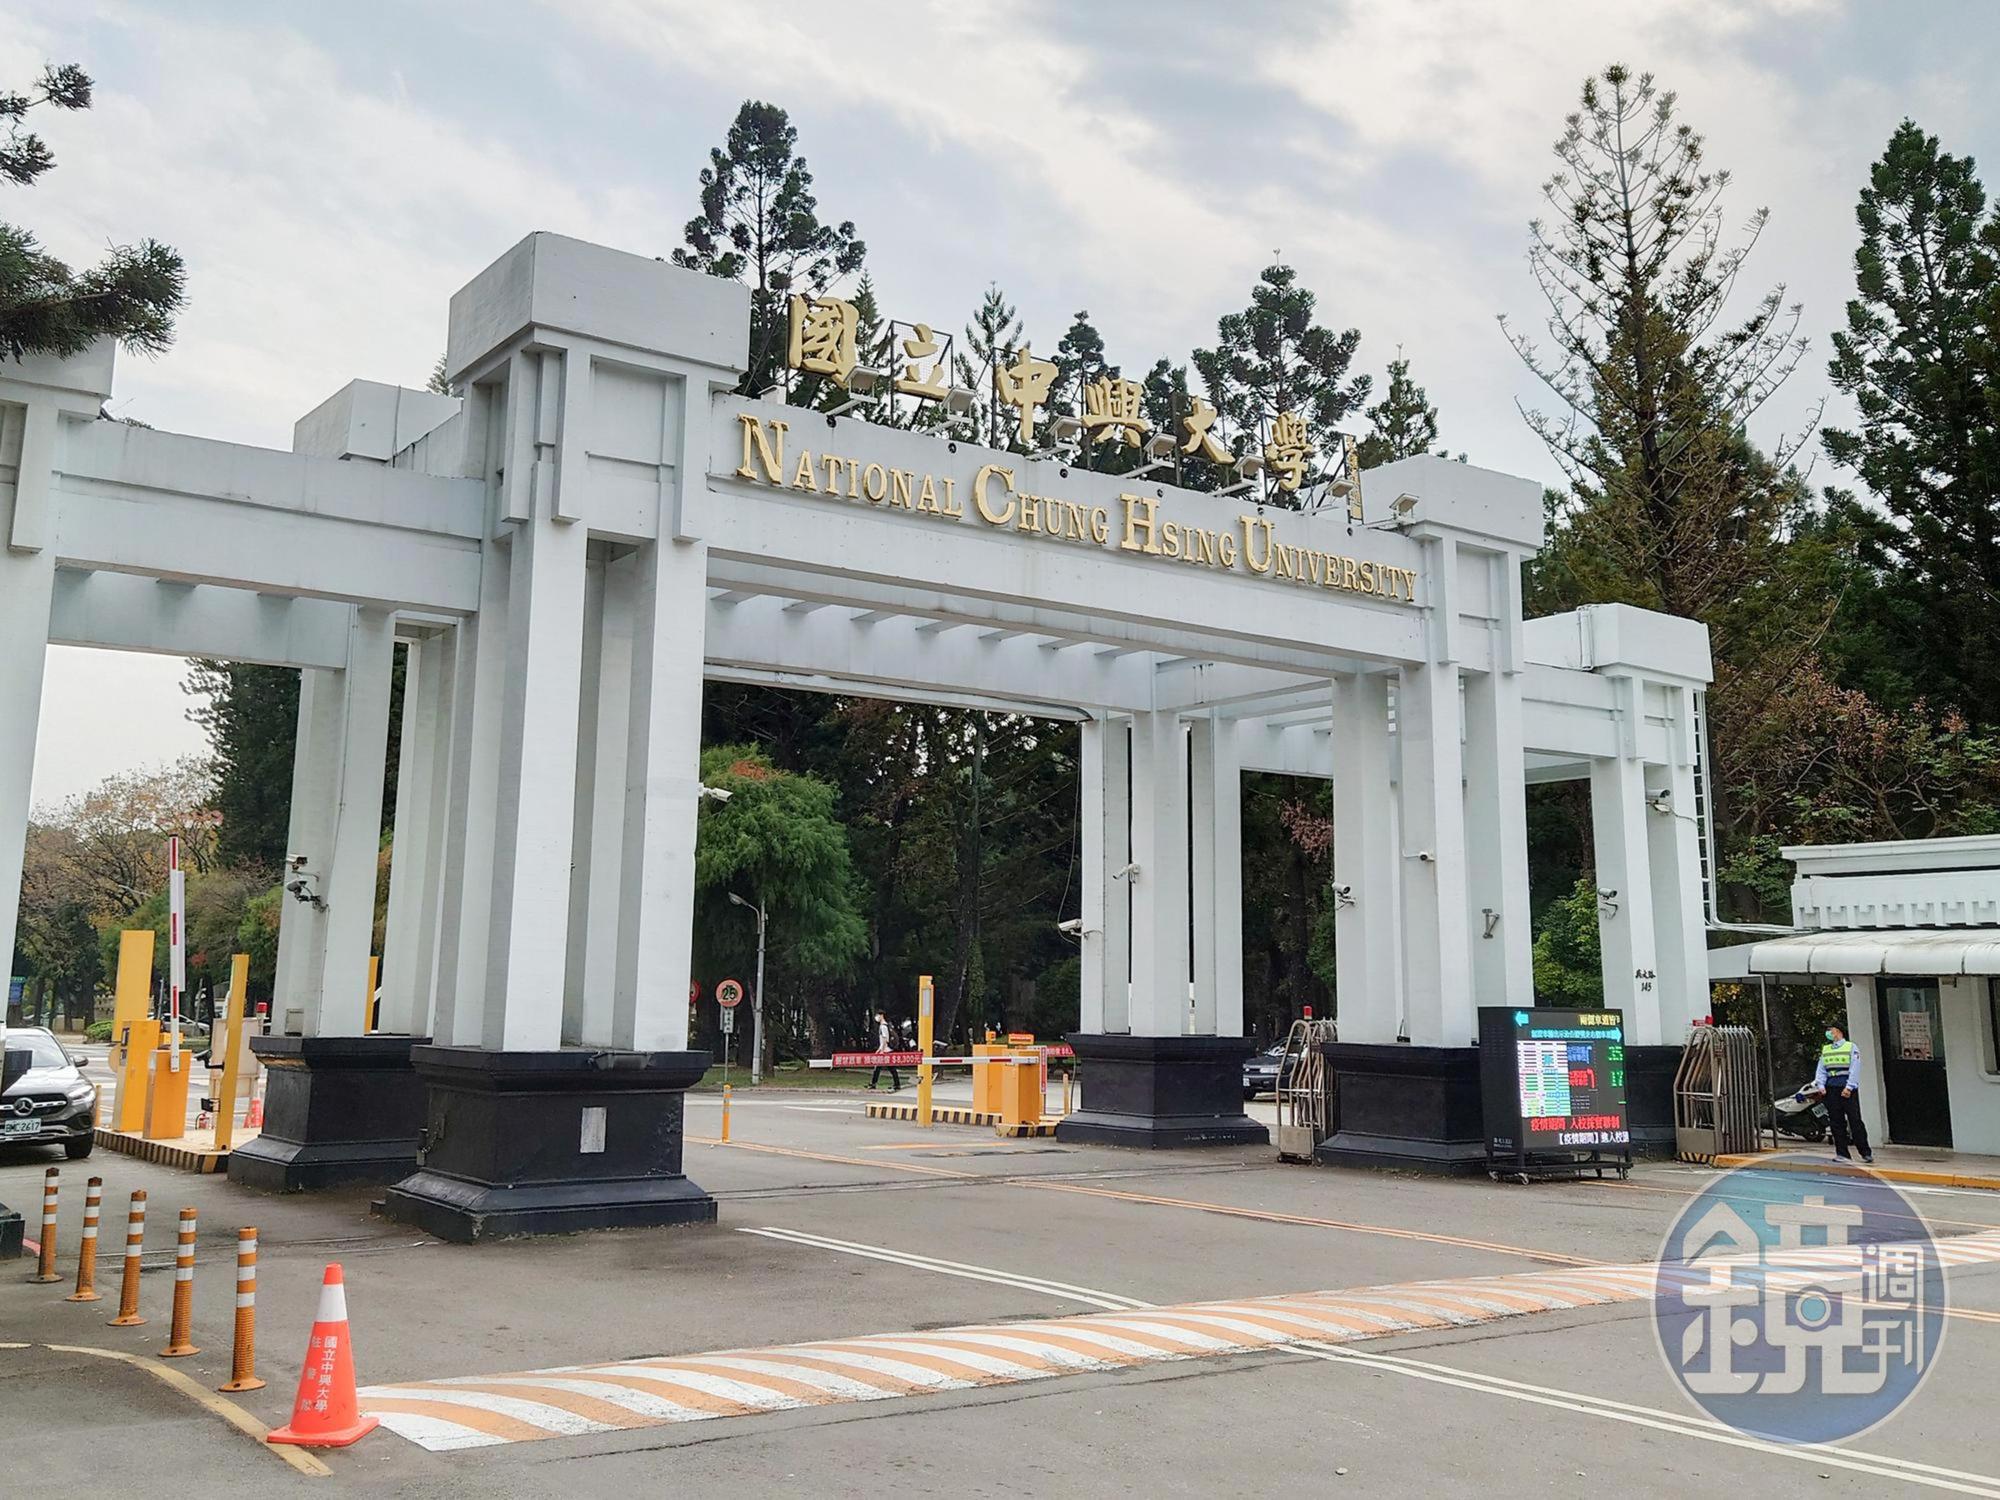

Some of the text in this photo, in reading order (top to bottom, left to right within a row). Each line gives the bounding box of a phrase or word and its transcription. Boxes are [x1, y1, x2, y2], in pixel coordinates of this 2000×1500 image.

[788, 293, 1314, 492] 國立中興大學
[736, 413, 1417, 602] NATIONAL CHUNG HSING UNIVERSITY
[722, 987, 737, 1000] 25
[315, 1335, 338, 1412] 國立中興大學
